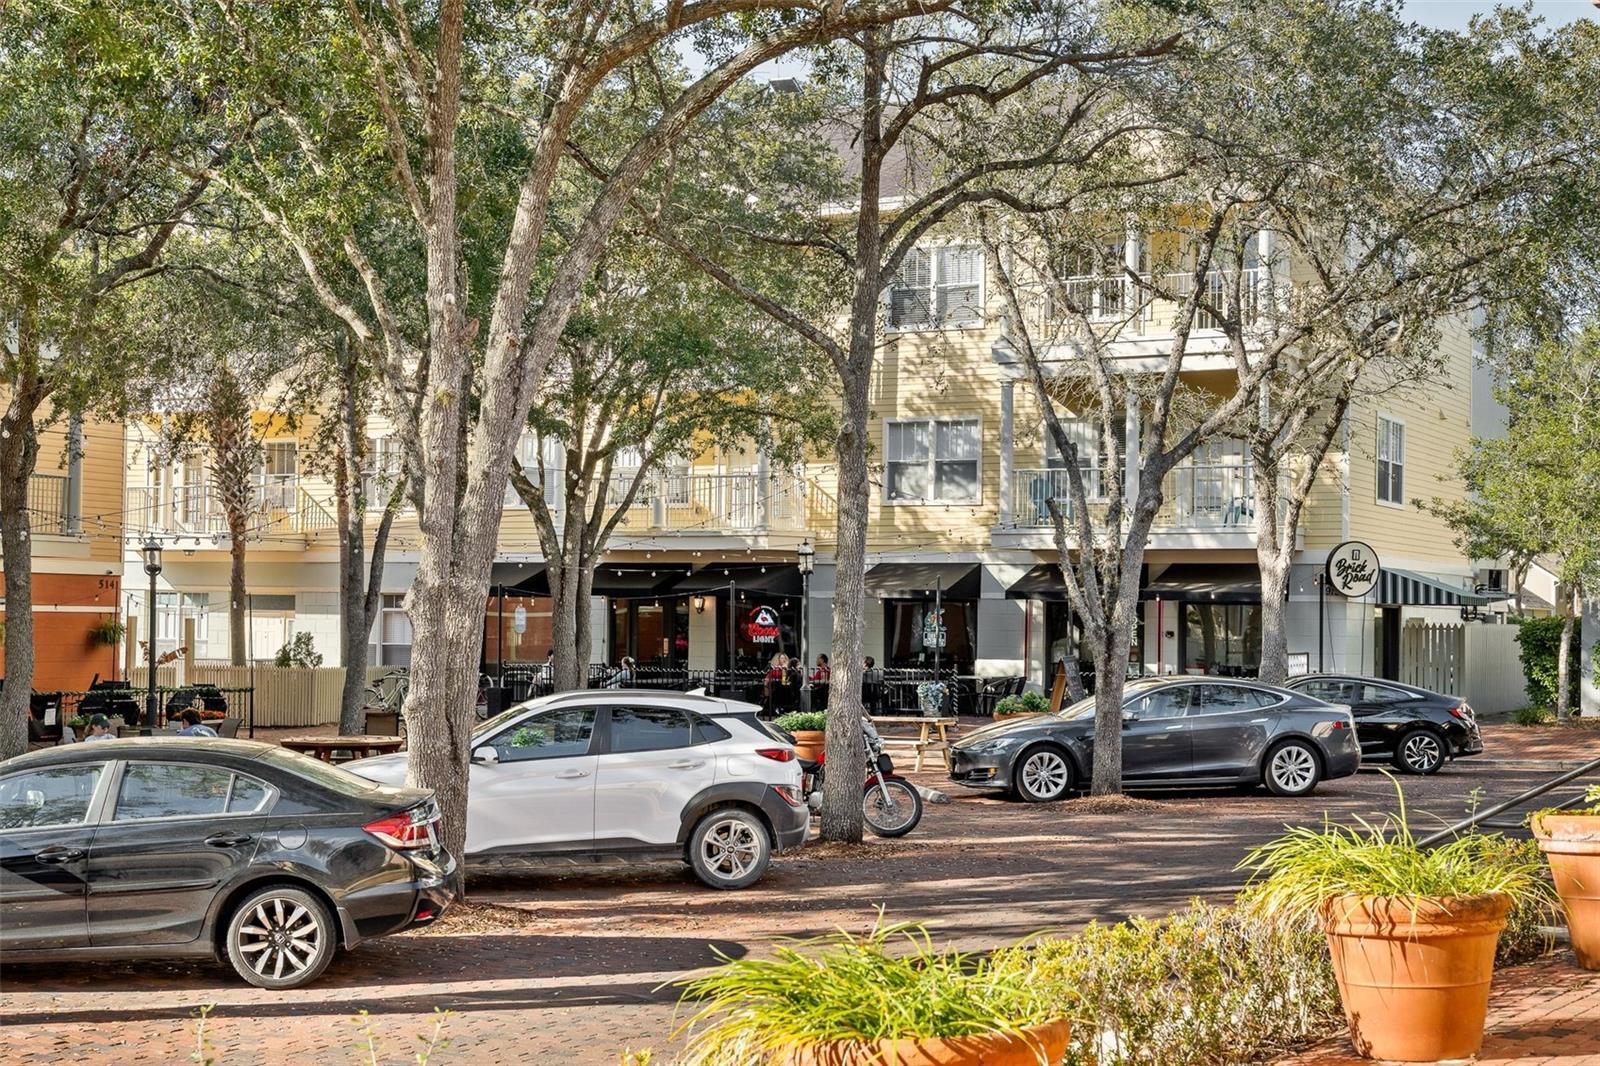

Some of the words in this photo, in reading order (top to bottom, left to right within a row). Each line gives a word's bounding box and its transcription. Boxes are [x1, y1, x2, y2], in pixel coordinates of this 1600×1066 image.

[1335, 558, 1368, 577] Brick
[98, 579, 115, 589] 514
[1342, 568, 1376, 590] Road
[752, 635, 775, 643] LIGHT
